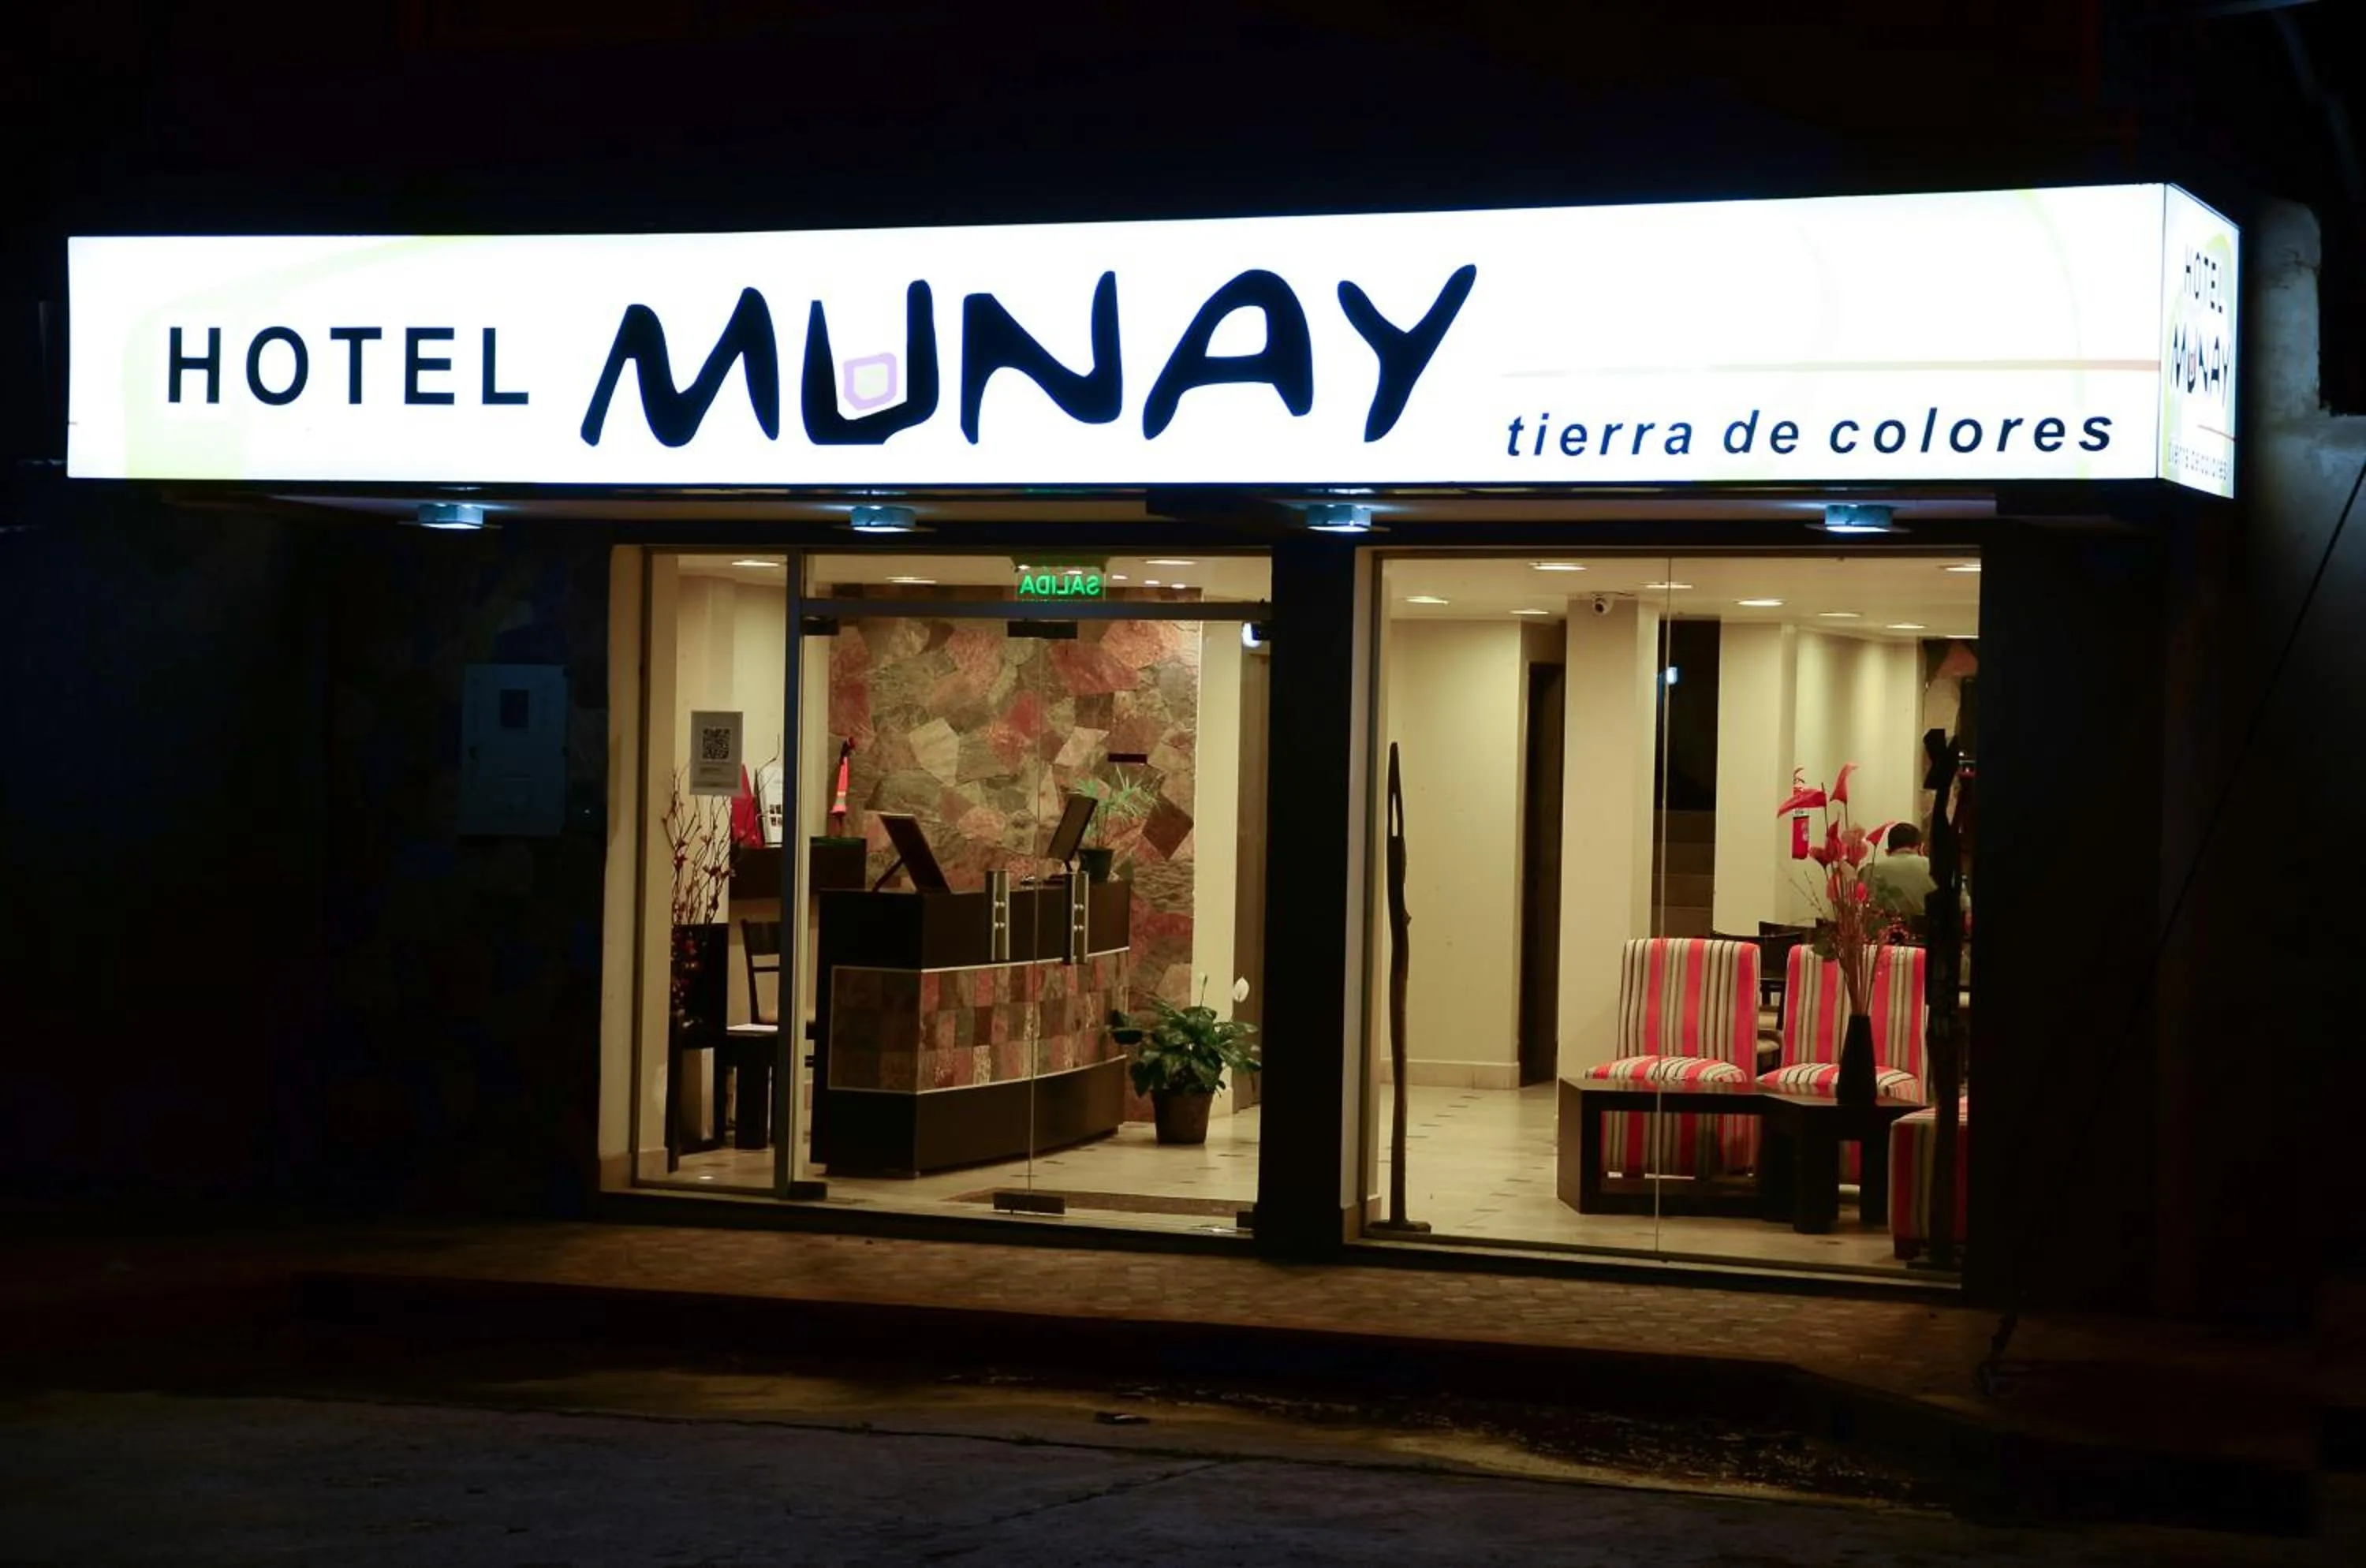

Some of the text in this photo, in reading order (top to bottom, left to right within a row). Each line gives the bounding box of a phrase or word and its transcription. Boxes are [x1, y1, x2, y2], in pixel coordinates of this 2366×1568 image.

[2184, 244, 2223, 314] HOTEL
[168, 264, 1477, 448] HOTEL MUNAY
[2170, 323, 2230, 408] MUNAY
[1507, 407, 2112, 457] tierra de colores
